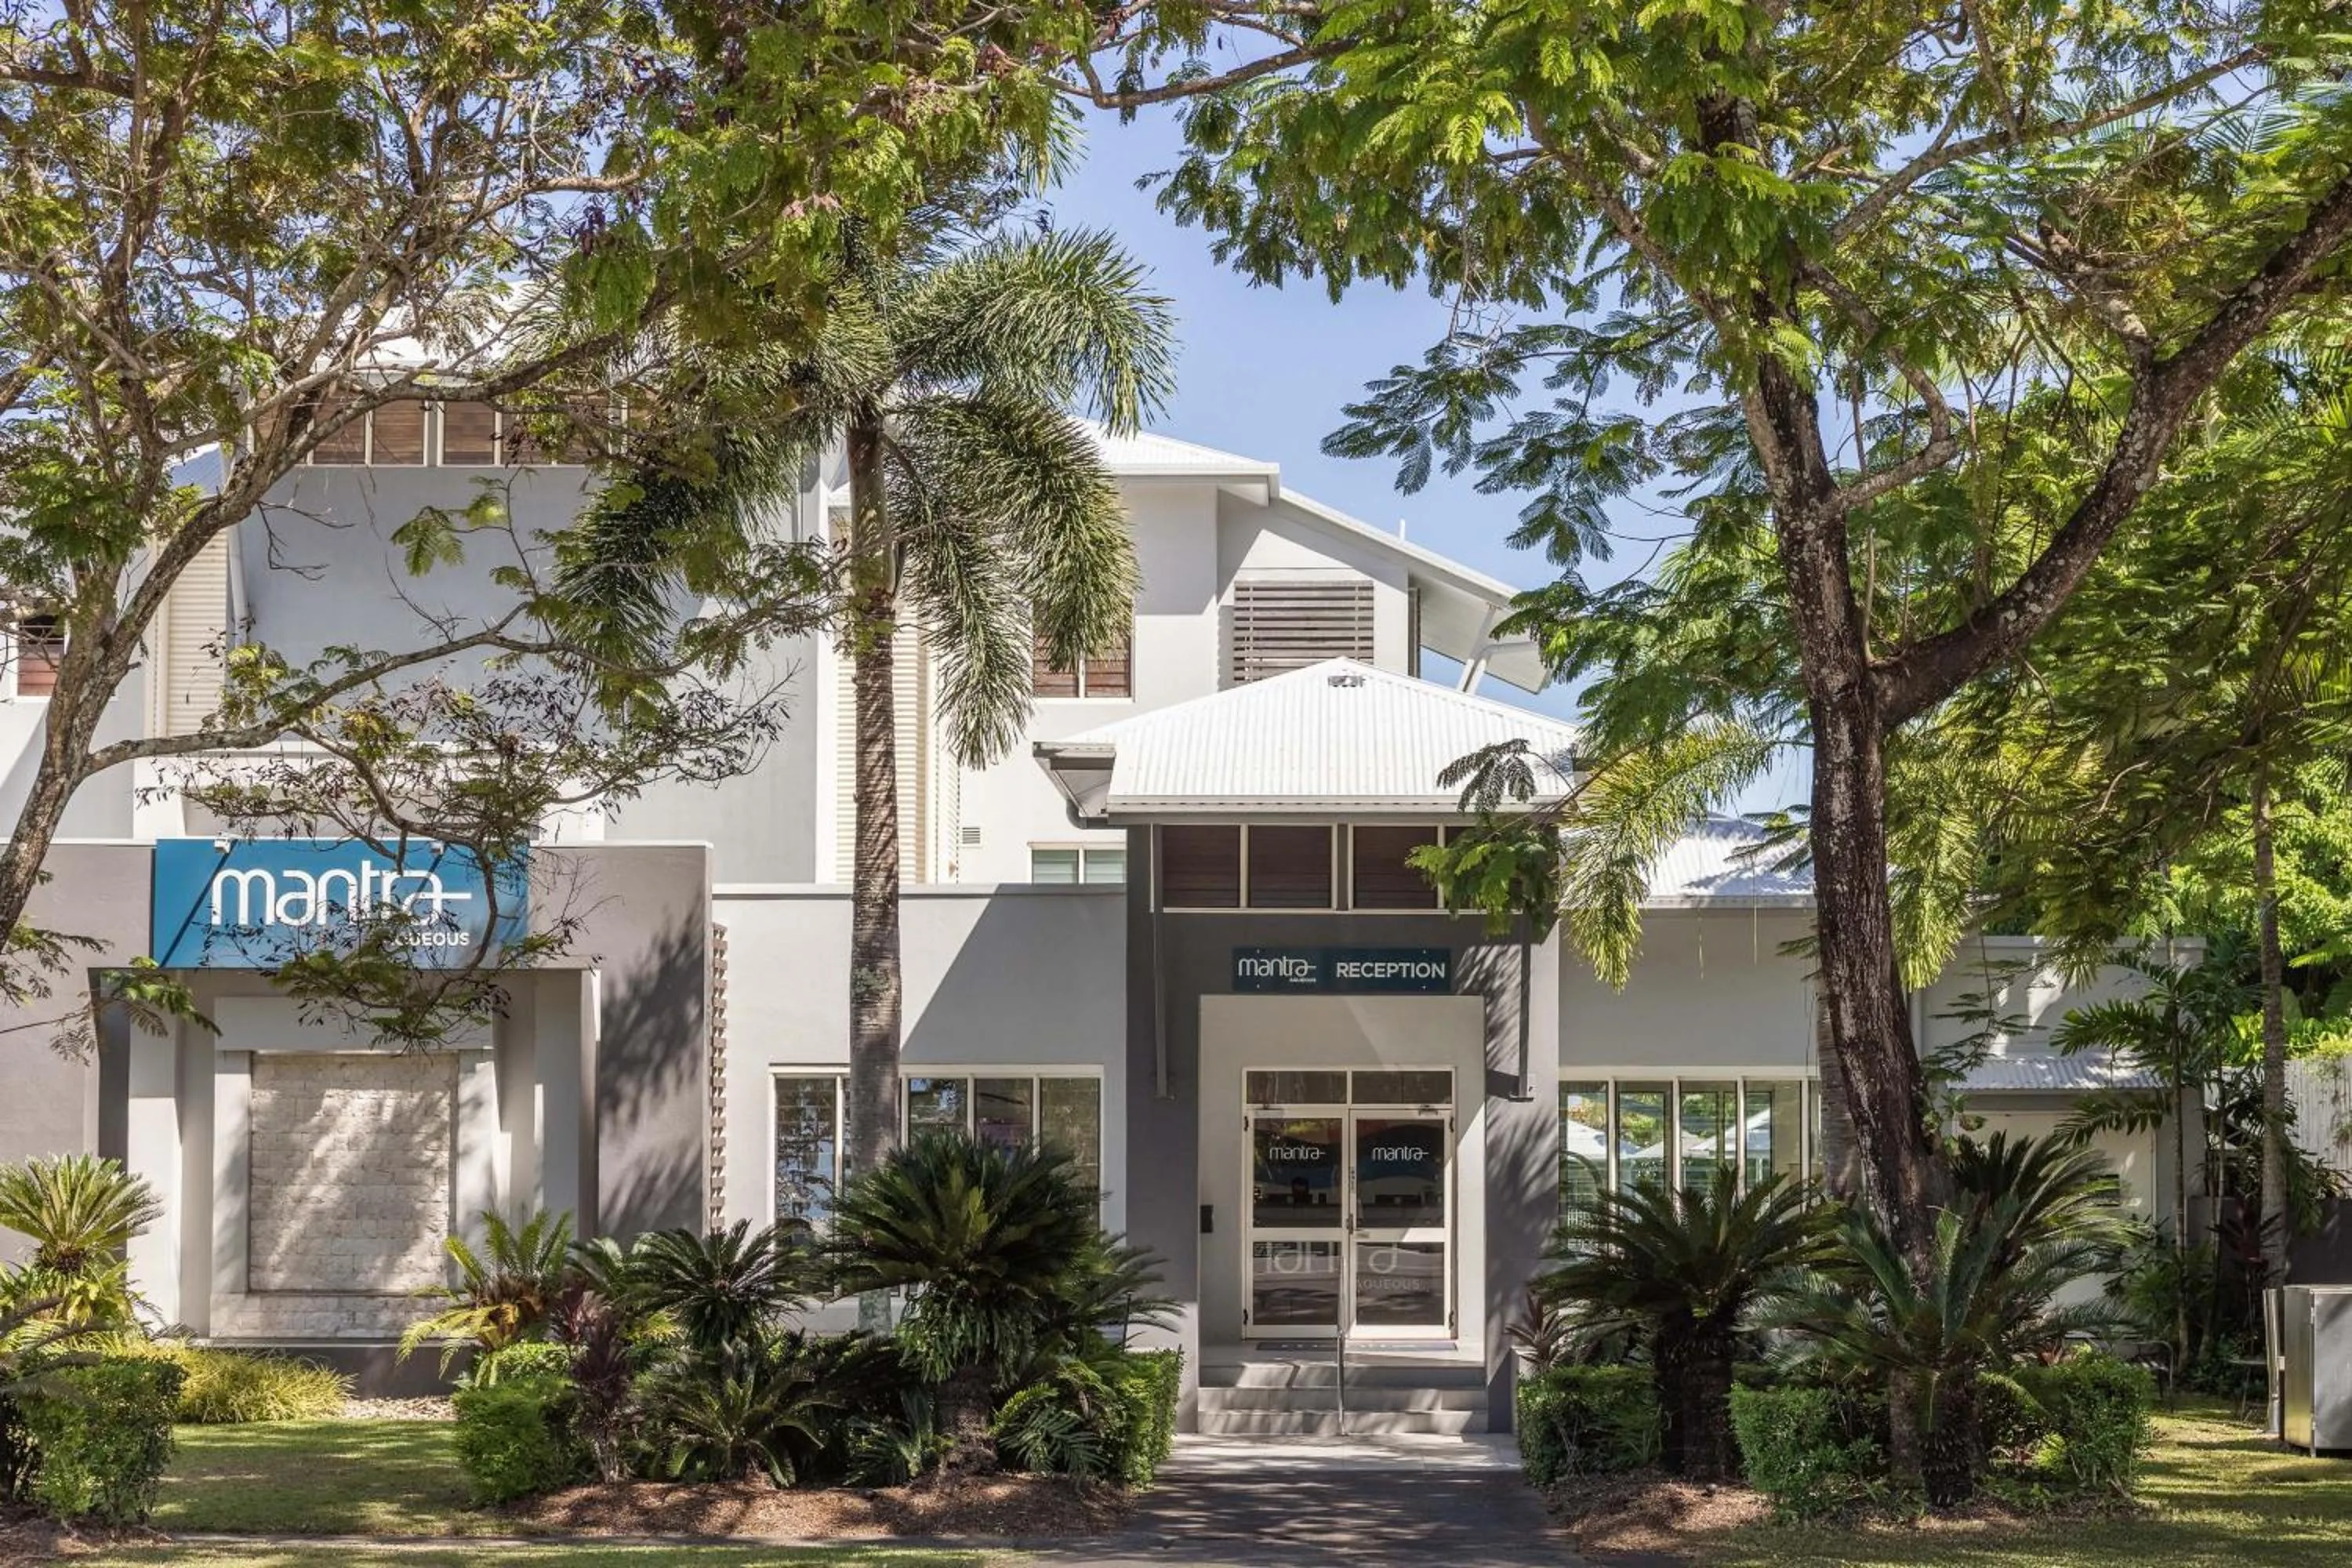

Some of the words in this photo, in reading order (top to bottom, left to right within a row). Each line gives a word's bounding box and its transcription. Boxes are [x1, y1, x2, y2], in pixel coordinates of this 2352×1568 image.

[211, 860, 471, 926] mantra
[1238, 956, 1316, 977] mantra
[1336, 962, 1445, 978] RECEPTION
[1269, 1146, 1326, 1160] mantra
[1373, 1146, 1429, 1161] mantra
